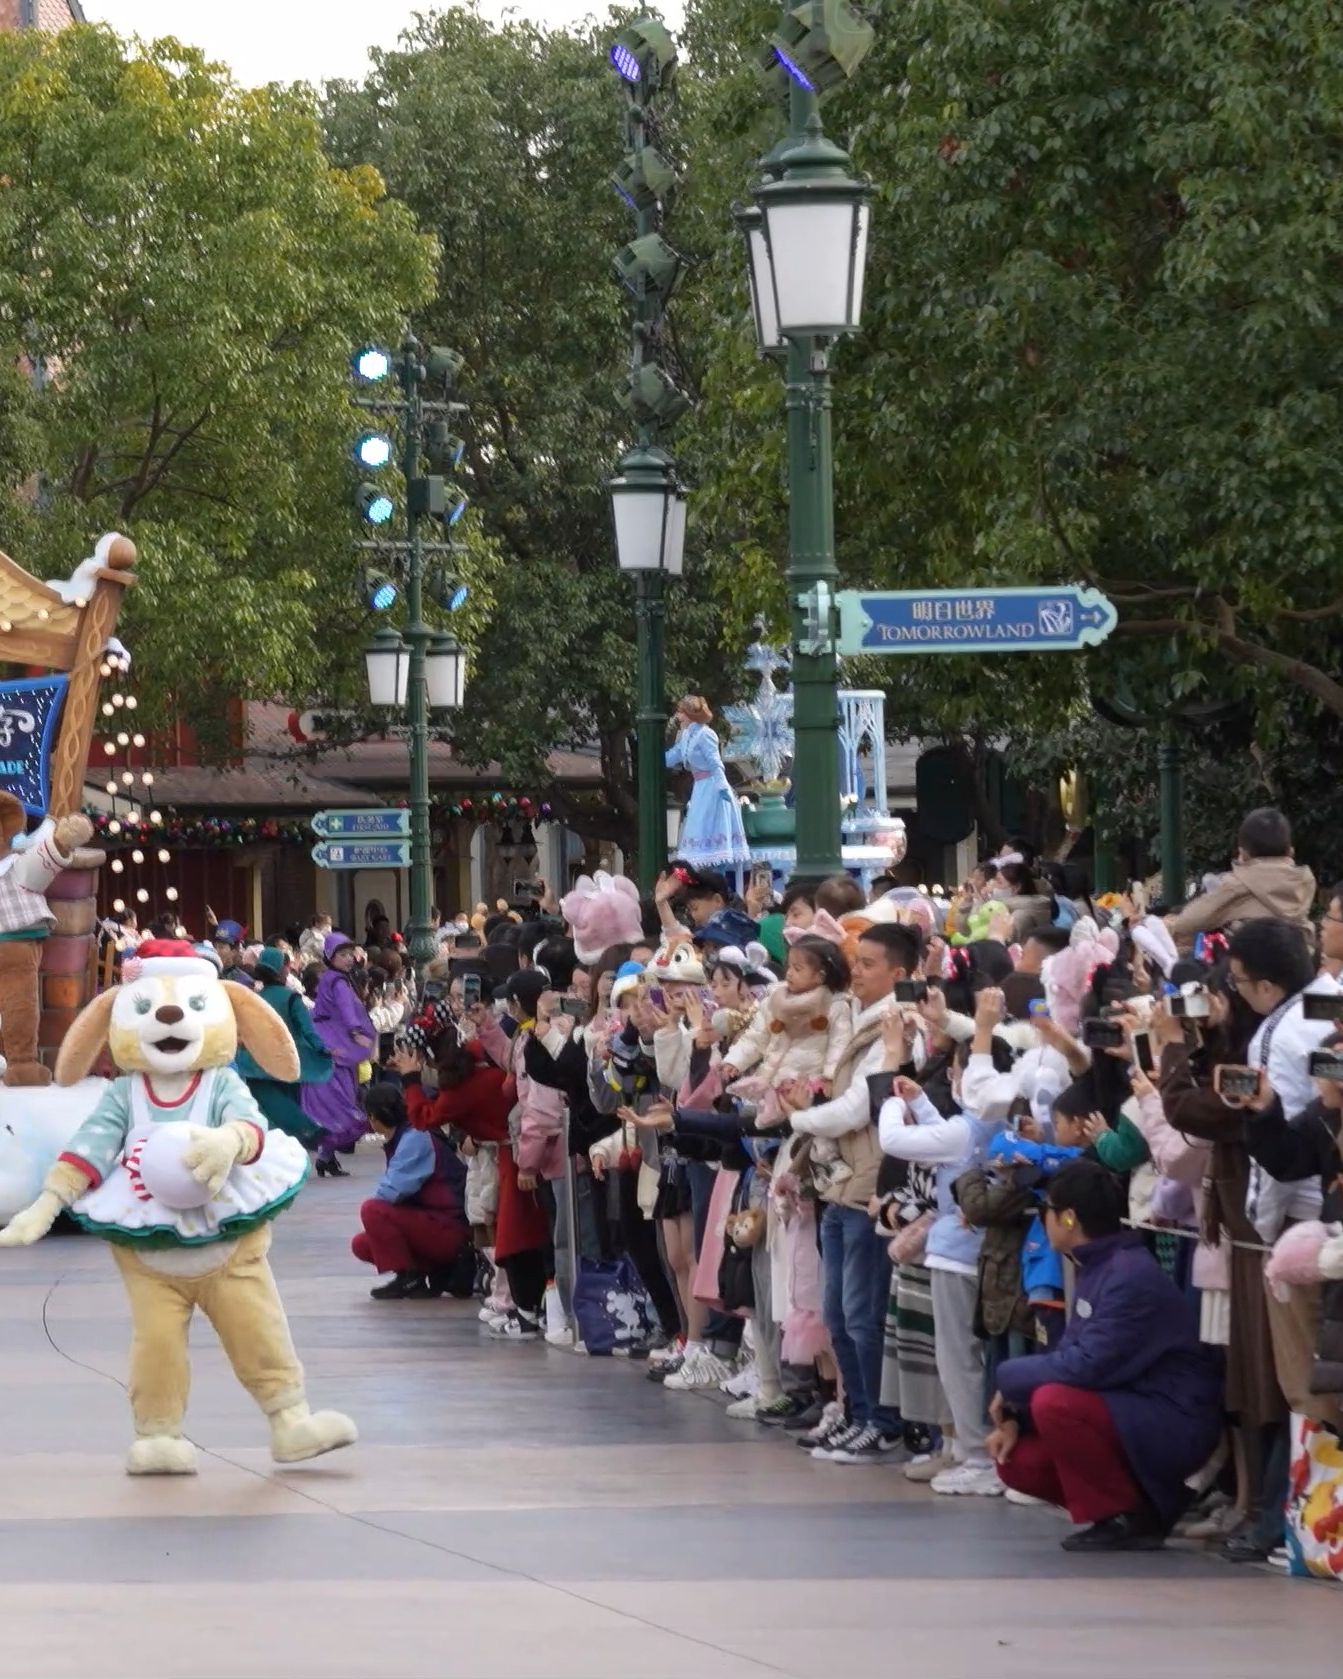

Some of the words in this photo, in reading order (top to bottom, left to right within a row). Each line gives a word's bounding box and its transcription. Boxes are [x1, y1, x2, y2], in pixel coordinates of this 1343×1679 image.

[912, 600, 996, 621] 明日世界
[877, 622, 1035, 641] TOMORROWLAND
